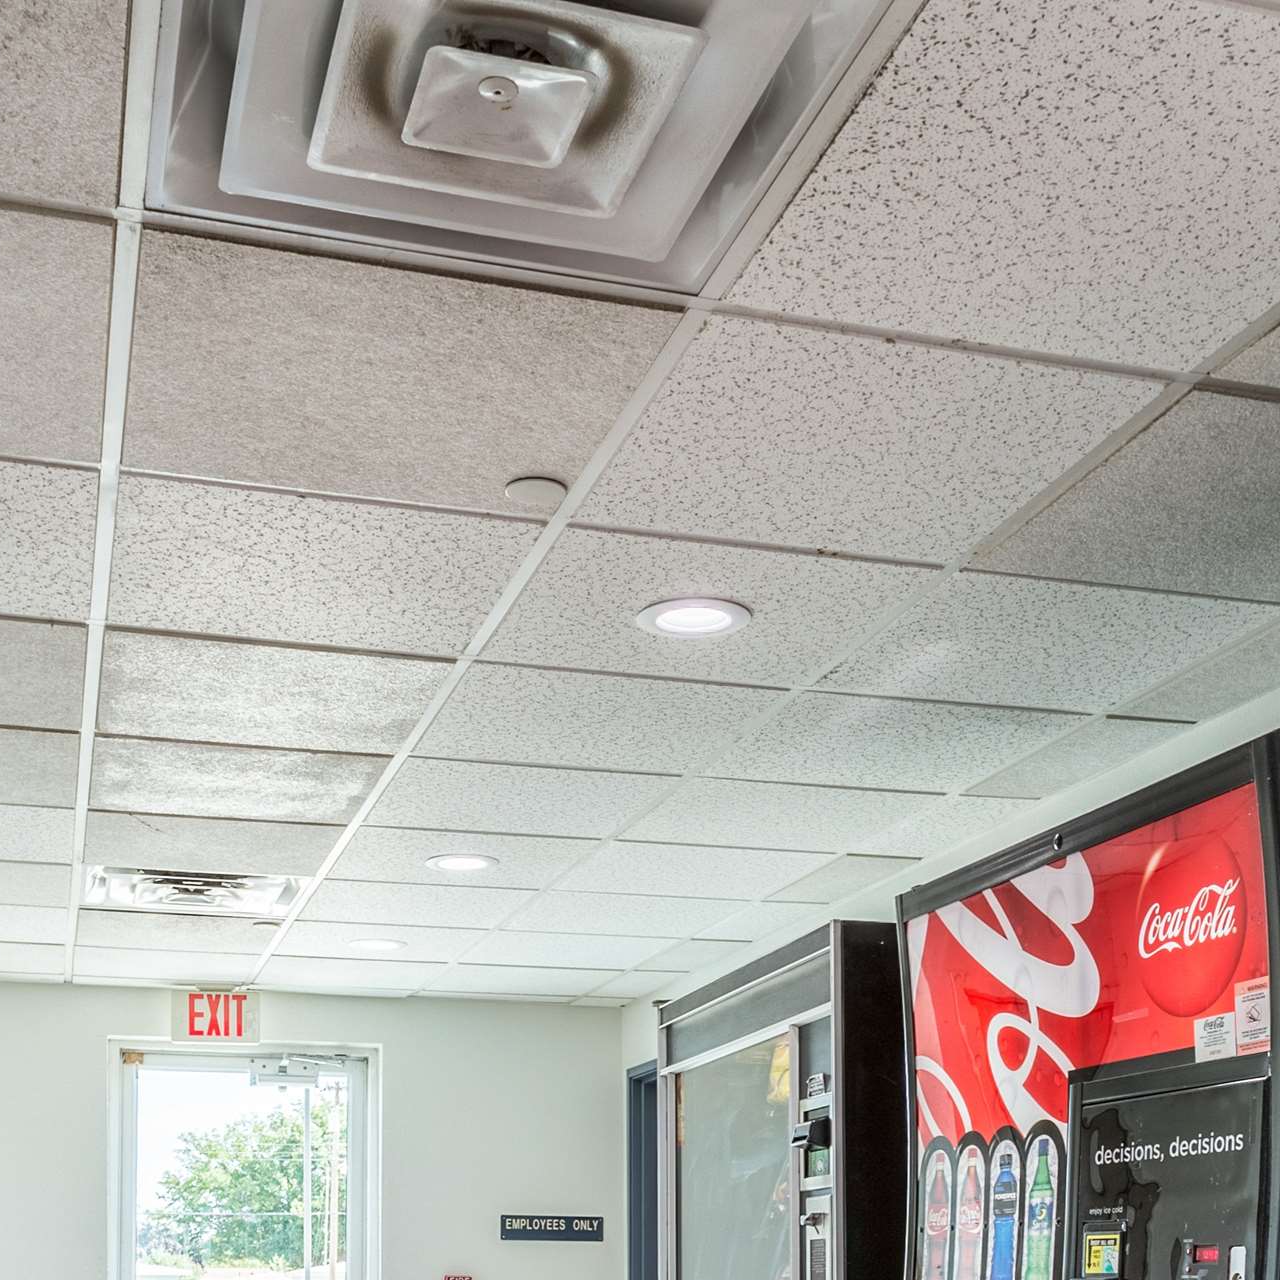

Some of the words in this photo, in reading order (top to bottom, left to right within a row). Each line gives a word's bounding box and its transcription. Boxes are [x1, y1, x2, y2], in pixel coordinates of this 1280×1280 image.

[1138, 876, 1240, 959] Coca-Cola
[188, 993, 248, 1037] EXIT
[1094, 1141, 1165, 1166] decisions,
[1169, 1131, 1244, 1158] decisions
[505, 1218, 566, 1231] EMPLOYEES
[572, 1219, 599, 1231] ONLY
